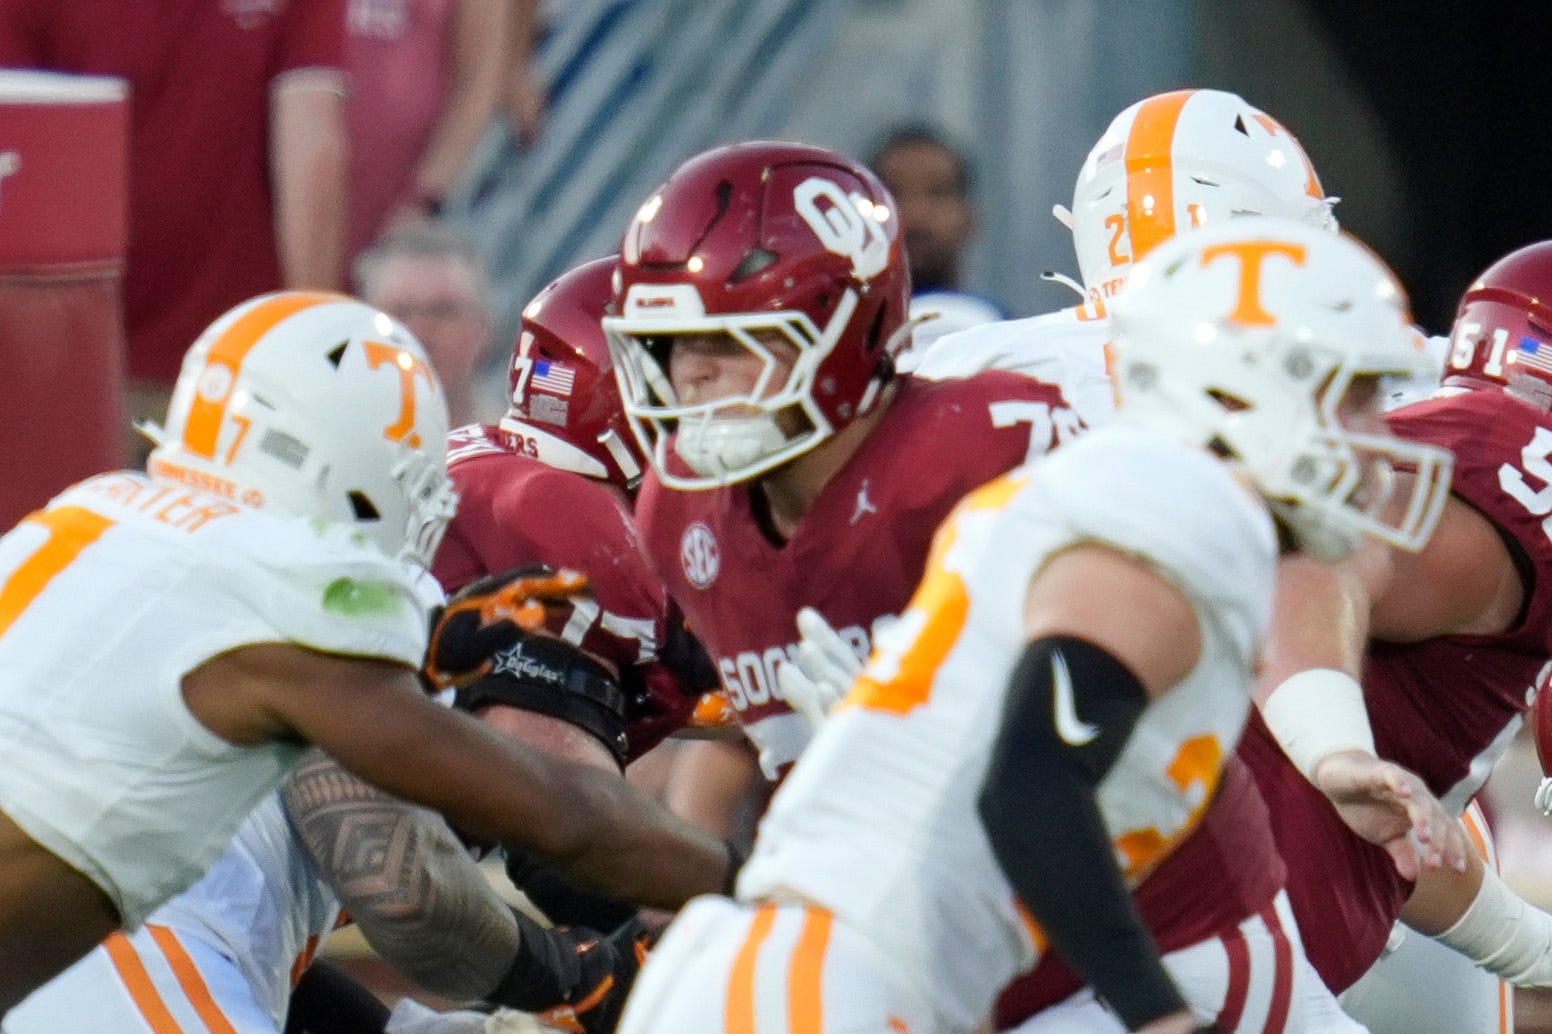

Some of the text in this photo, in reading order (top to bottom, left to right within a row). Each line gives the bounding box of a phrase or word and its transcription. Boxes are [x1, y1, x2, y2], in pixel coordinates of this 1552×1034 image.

[793, 177, 889, 280] OU
[1200, 239, 1306, 328] T
[362, 339, 436, 449] T
[1451, 321, 1509, 378] 51
[225, 415, 253, 466] 7
